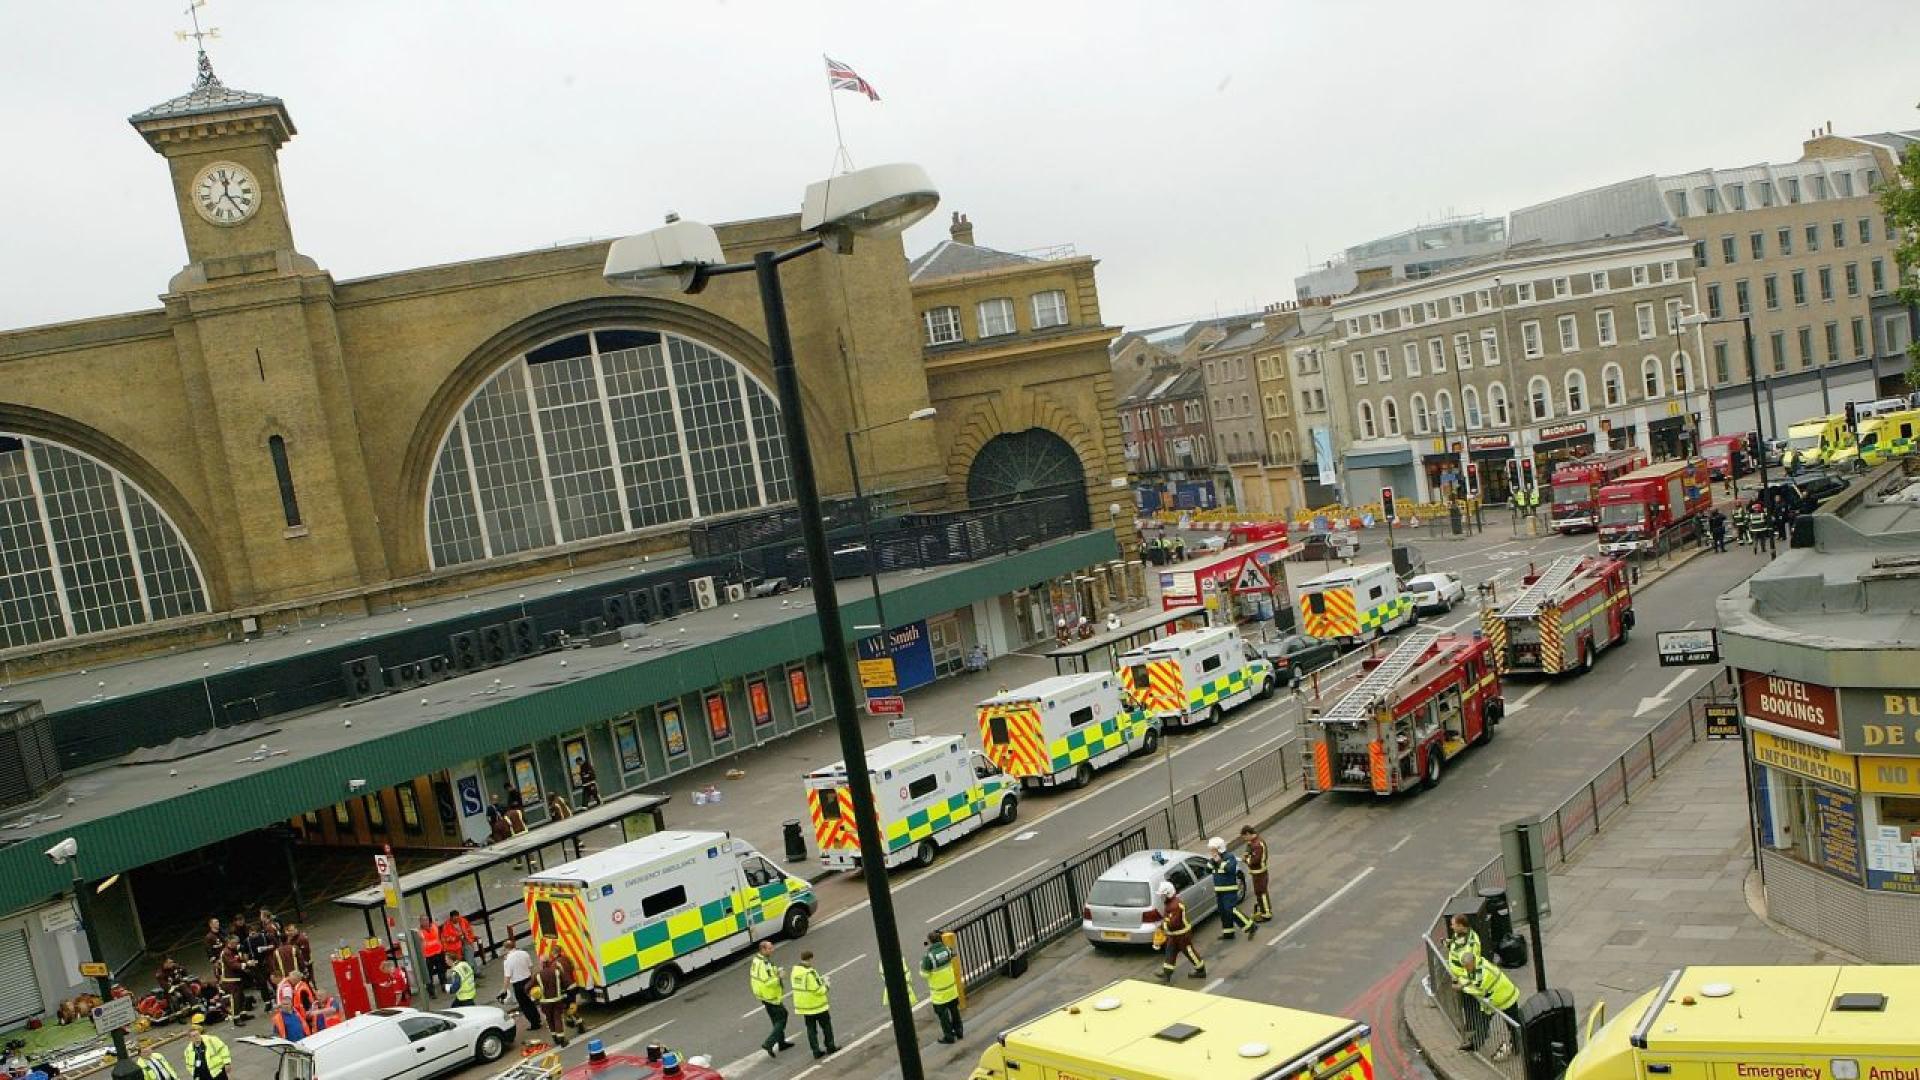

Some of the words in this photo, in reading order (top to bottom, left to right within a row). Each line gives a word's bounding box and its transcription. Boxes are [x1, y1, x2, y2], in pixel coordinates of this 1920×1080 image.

[889, 624, 920, 645] Smith
[1768, 676, 1810, 702] HOTEL
[1760, 693, 1825, 726] BOOKINGS
[1773, 733, 1828, 763] TOURIST
[1862, 724, 1906, 746] DE
[1759, 746, 1852, 786] INFORMATION
[1736, 1063, 1822, 1080] Emergency
